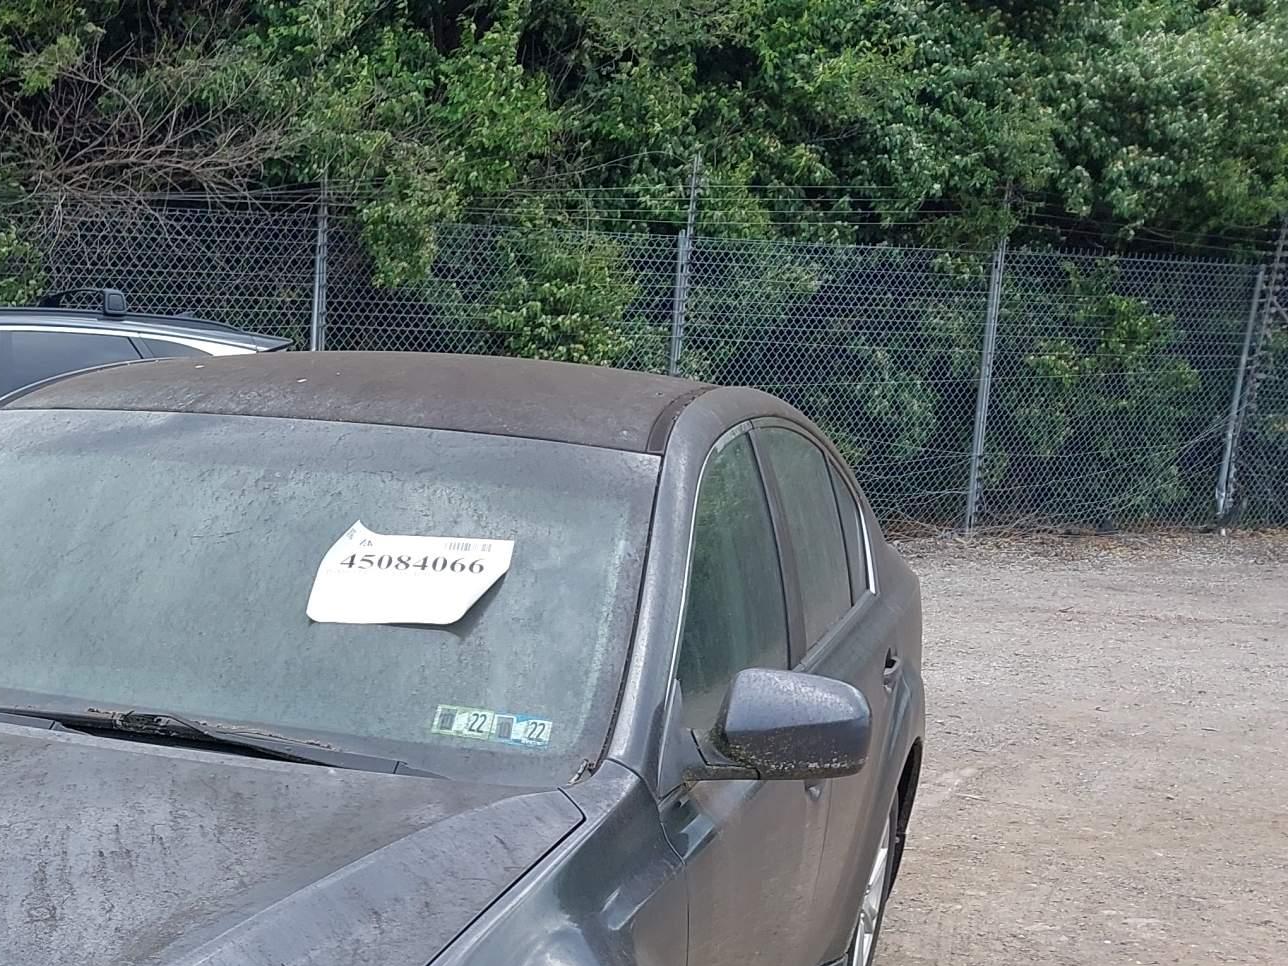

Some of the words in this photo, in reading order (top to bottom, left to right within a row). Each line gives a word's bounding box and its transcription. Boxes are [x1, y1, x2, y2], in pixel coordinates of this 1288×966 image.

[340, 553, 485, 575] 45084066
[468, 713, 487, 733] 22
[528, 721, 546, 739] 22
